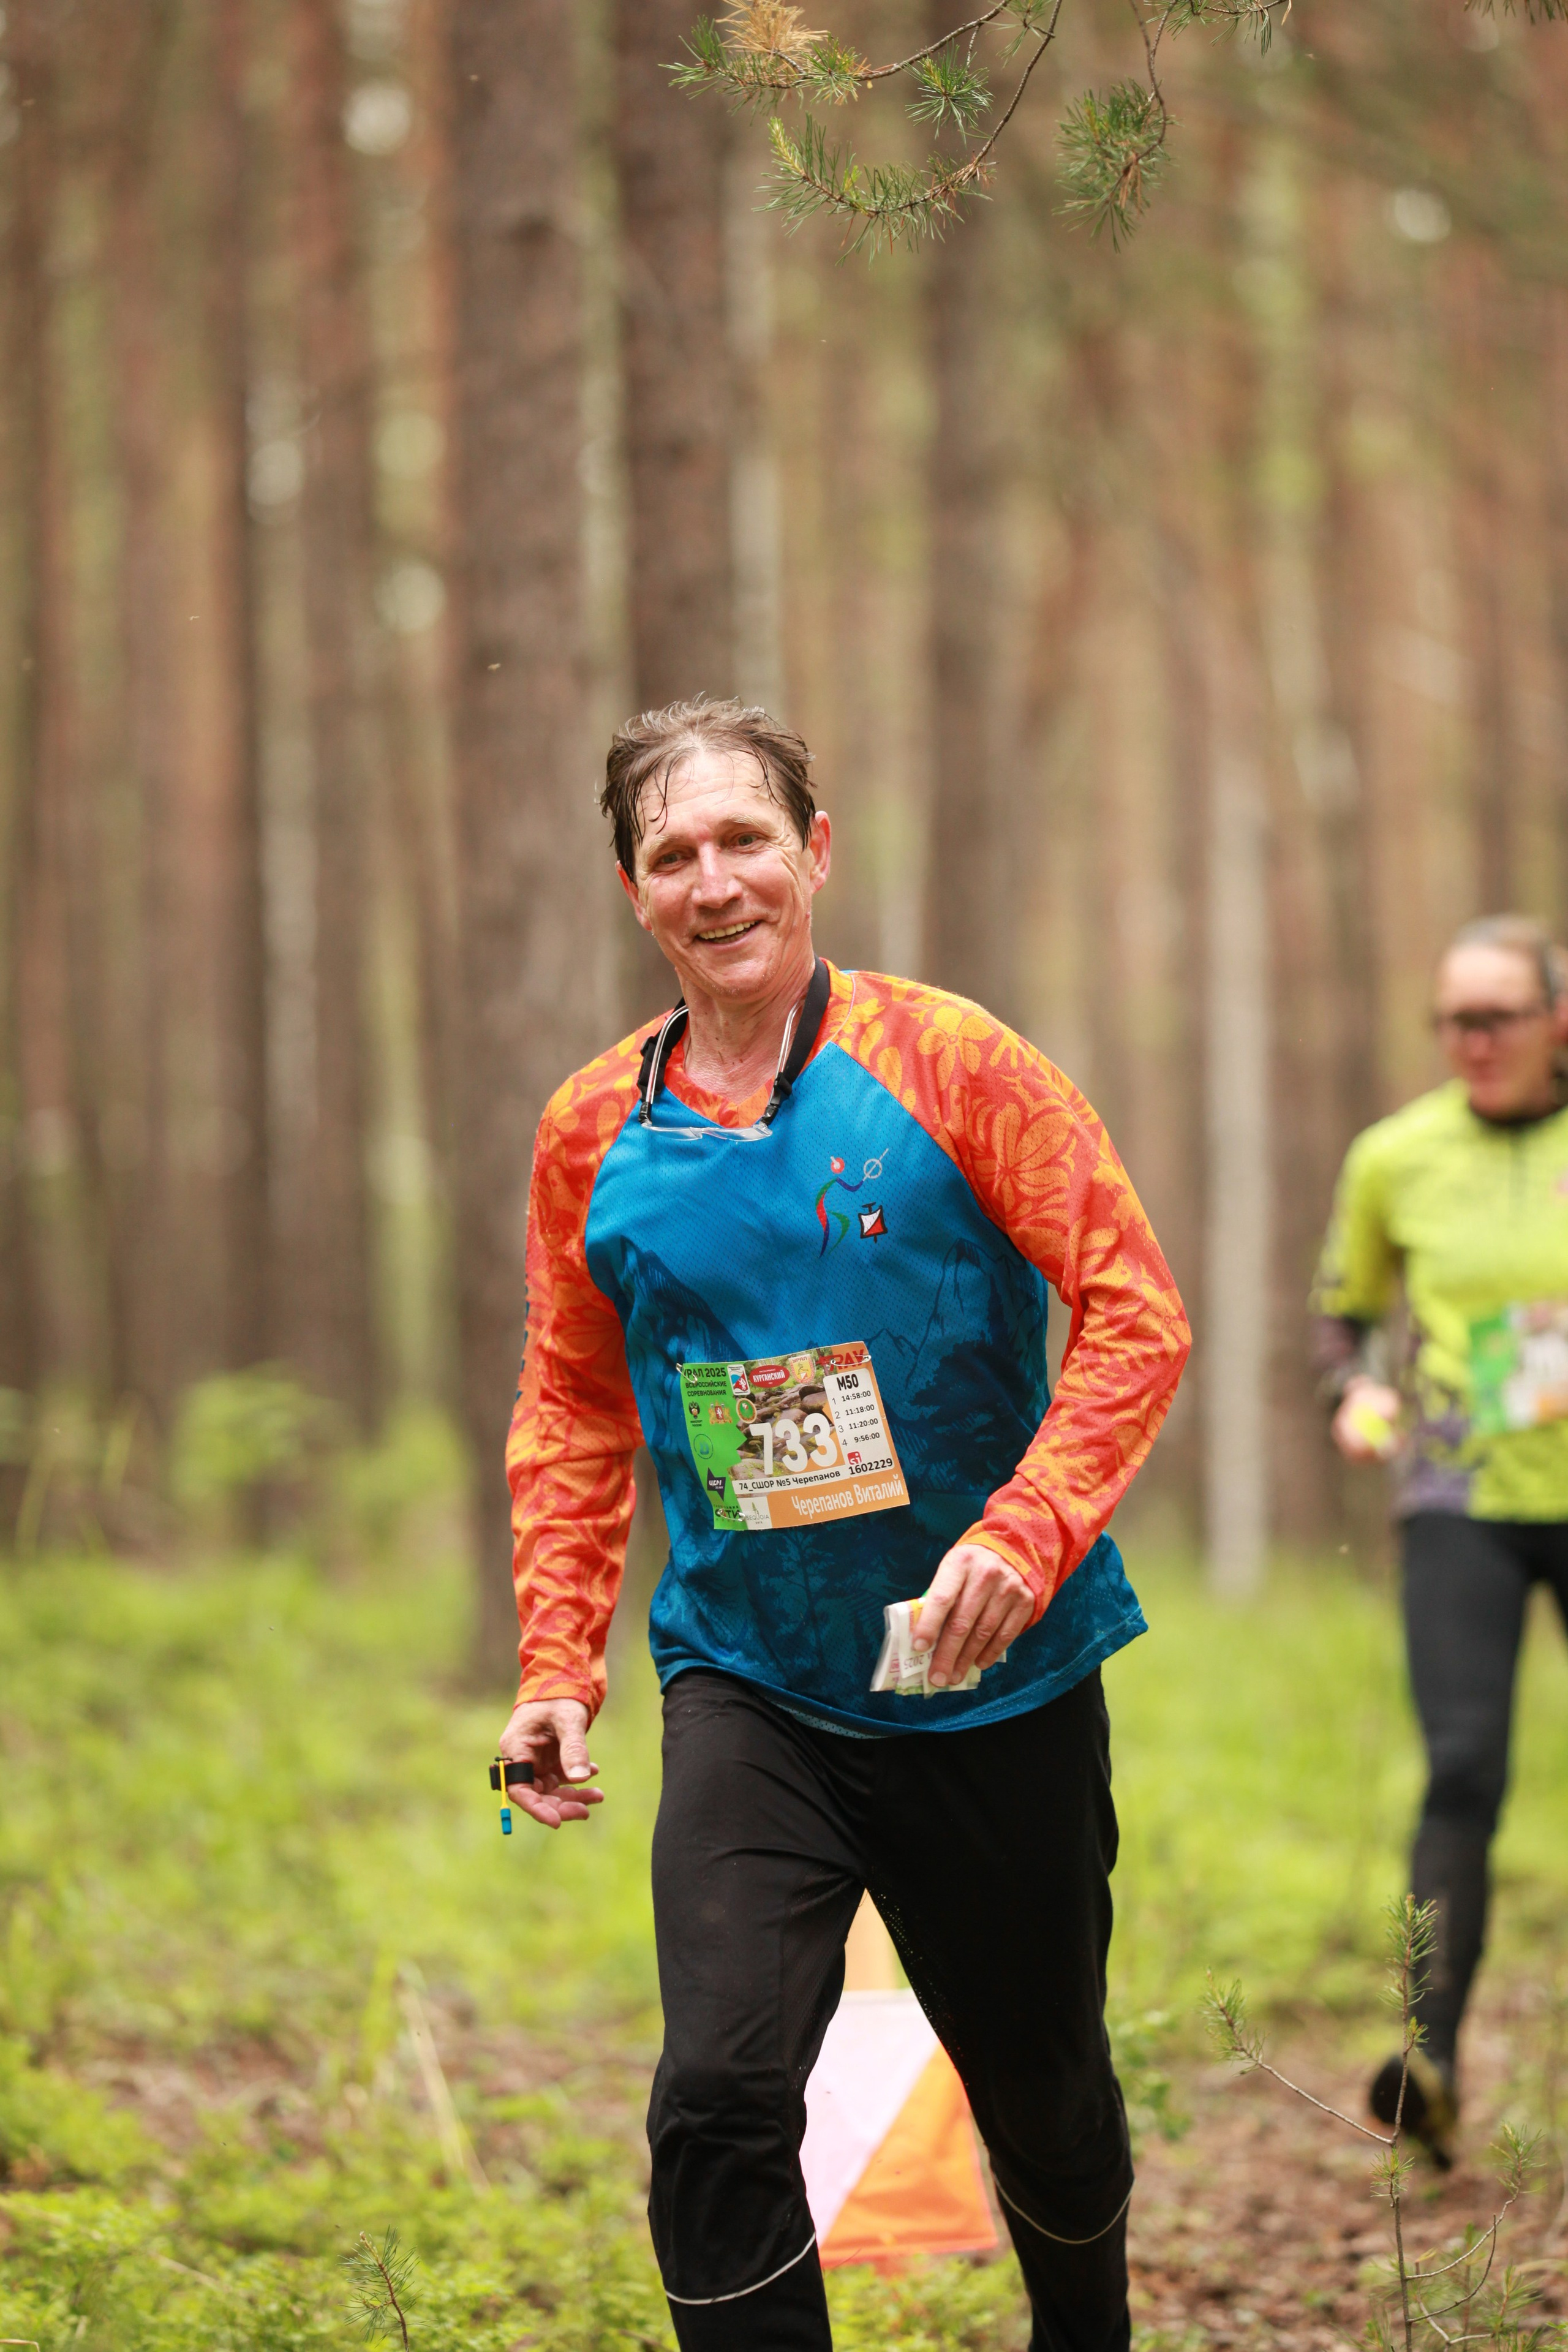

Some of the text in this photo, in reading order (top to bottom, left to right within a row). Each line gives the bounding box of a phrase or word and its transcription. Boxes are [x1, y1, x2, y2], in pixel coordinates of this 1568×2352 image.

[704, 1367, 726, 1378] 2025
[753, 1370, 786, 1382] КУРГАНСКИЙ
[842, 1390, 871, 1402] 14:58:00
[845, 1404, 875, 1415] 11:18:00
[849, 1418, 878, 1430] 11:20:00
[854, 1432, 880, 1442] 9:56:00
[749, 1412, 838, 1475] 733
[848, 1458, 893, 1475] 1602229
[739, 1471, 841, 1491] 74_СШОР №5 Черепанов
[791, 1474, 904, 1520] Черепанов Виталий
